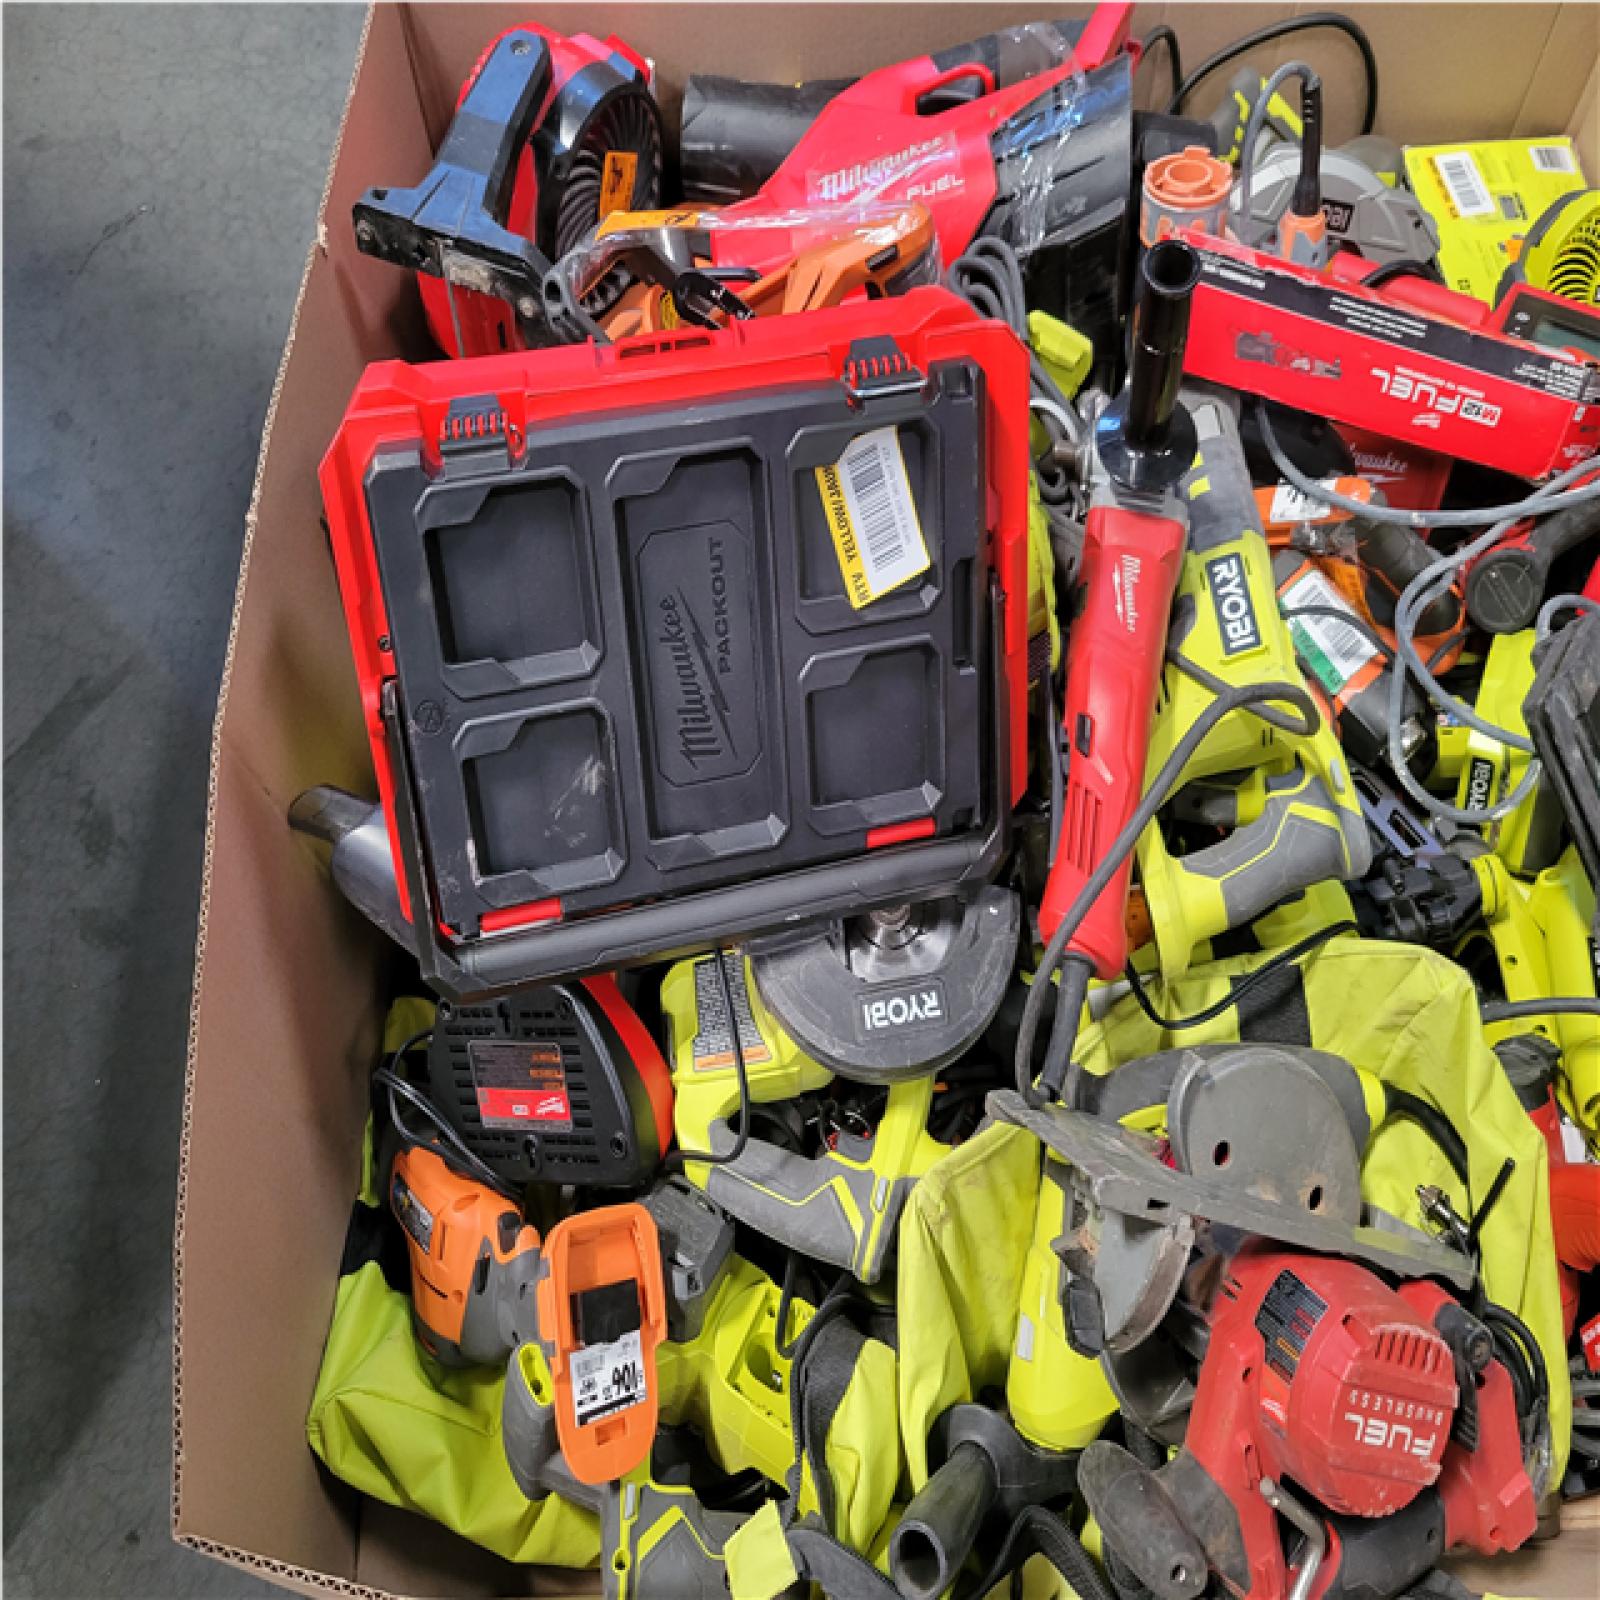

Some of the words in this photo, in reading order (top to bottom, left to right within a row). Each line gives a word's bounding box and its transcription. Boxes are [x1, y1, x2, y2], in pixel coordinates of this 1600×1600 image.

[905, 174, 966, 201] FUEL
[1370, 367, 1461, 414] FUEL
[708, 536, 732, 674] PACKOUT
[1120, 554, 1142, 633] Milwaukee
[1211, 557, 1256, 649] RYOBI
[659, 594, 721, 771] Milwaukee
[862, 989, 943, 1031] RYOBI
[1344, 1412, 1437, 1456] FUEL
